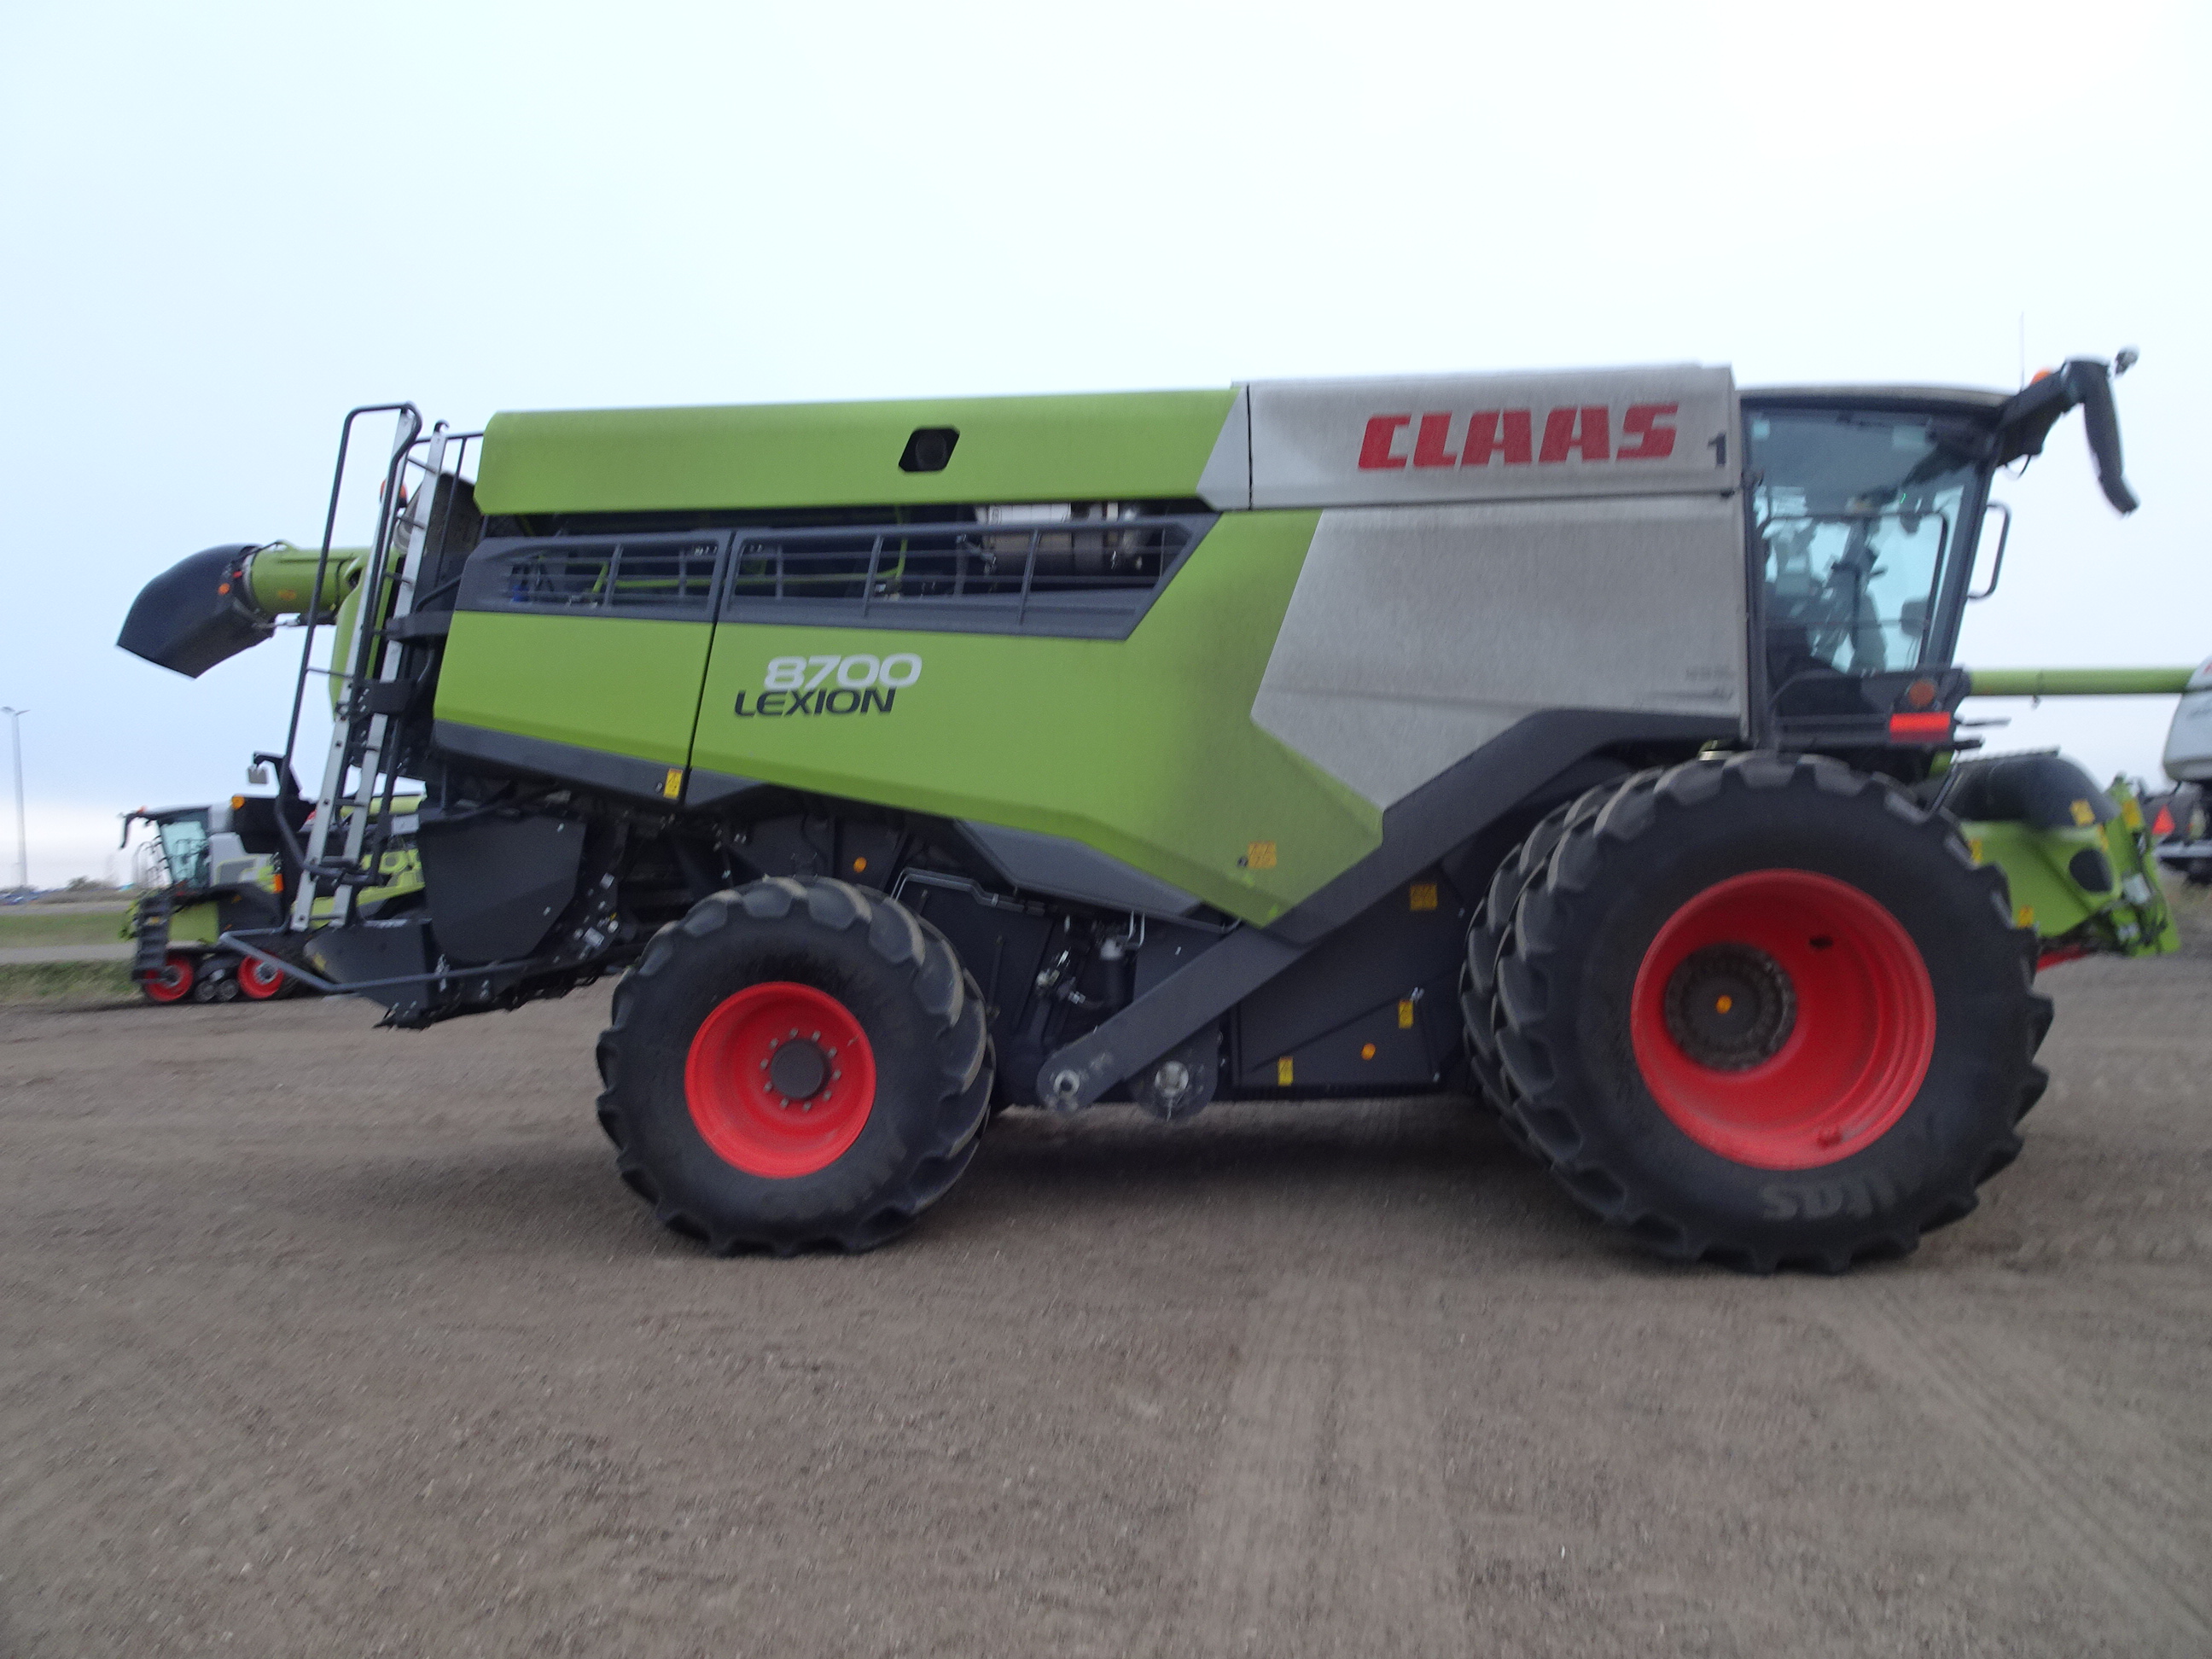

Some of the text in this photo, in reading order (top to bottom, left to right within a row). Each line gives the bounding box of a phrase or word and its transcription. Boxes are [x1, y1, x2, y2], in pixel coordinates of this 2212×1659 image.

[1359, 402, 1679, 471] CLAAS
[764, 653, 923, 691] 8700
[734, 687, 897, 718] LEXION
